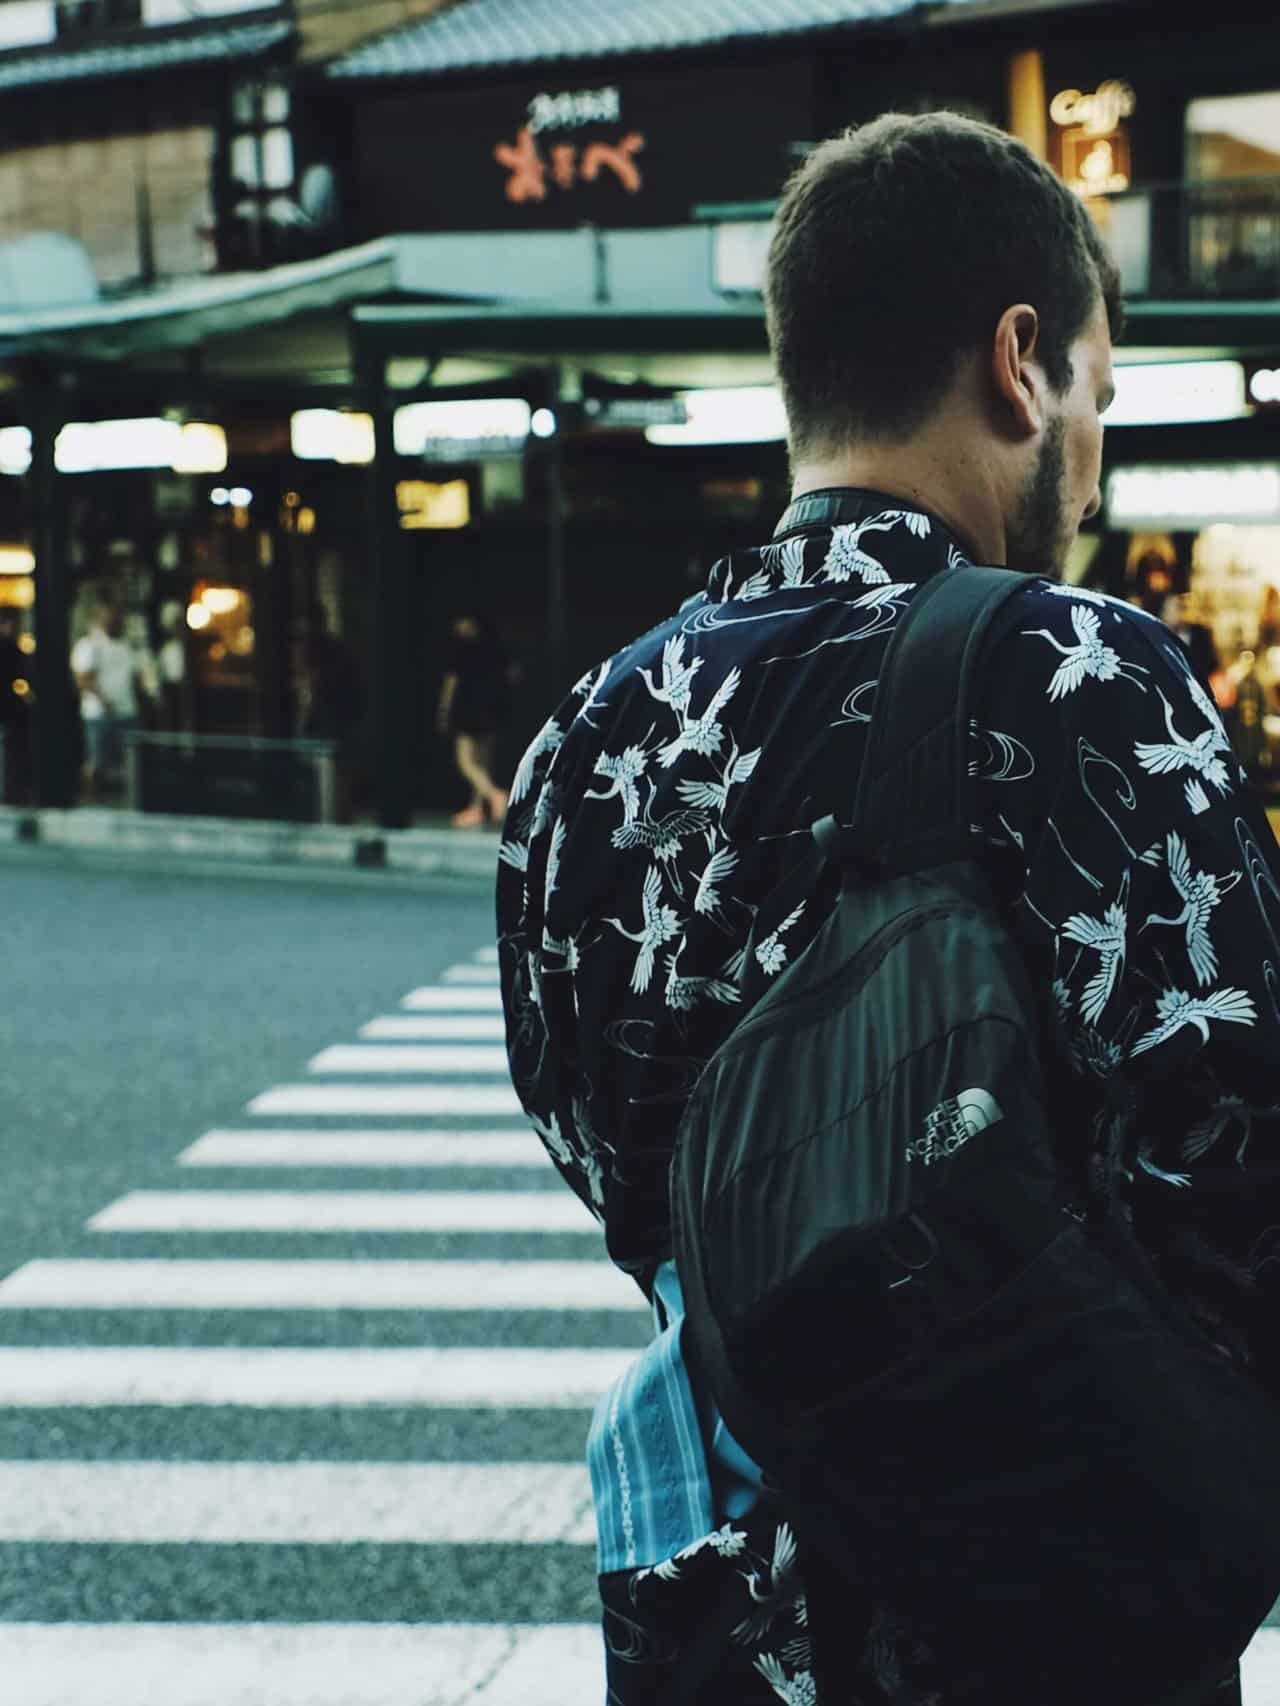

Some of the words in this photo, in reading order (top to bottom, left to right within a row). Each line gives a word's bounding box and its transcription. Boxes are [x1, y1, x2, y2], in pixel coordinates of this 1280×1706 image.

[924, 1097, 958, 1128] THE
[905, 1114, 965, 1162] NORTH
[924, 1127, 968, 1166] FACE
